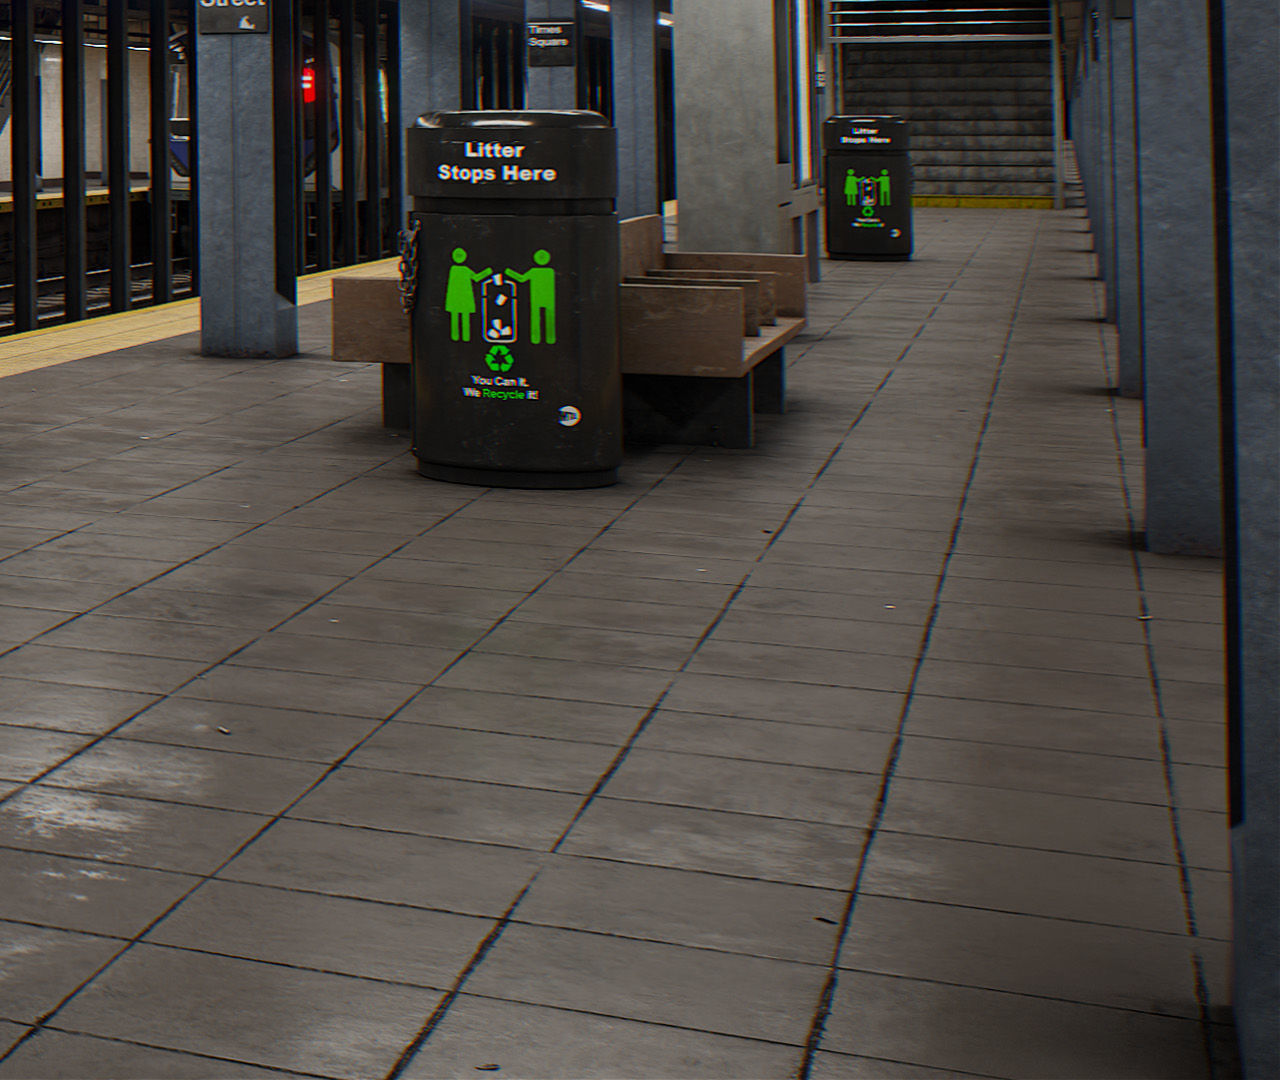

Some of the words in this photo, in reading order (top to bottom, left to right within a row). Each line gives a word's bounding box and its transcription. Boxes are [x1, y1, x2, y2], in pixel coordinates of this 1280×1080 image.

[528, 25, 563, 35] Times
[528, 36, 569, 49] Square
[464, 141, 526, 158] Litter
[437, 164, 496, 184] Stops
[501, 164, 558, 181] Here
[470, 374, 494, 386] You
[482, 388, 526, 401] Recycle
